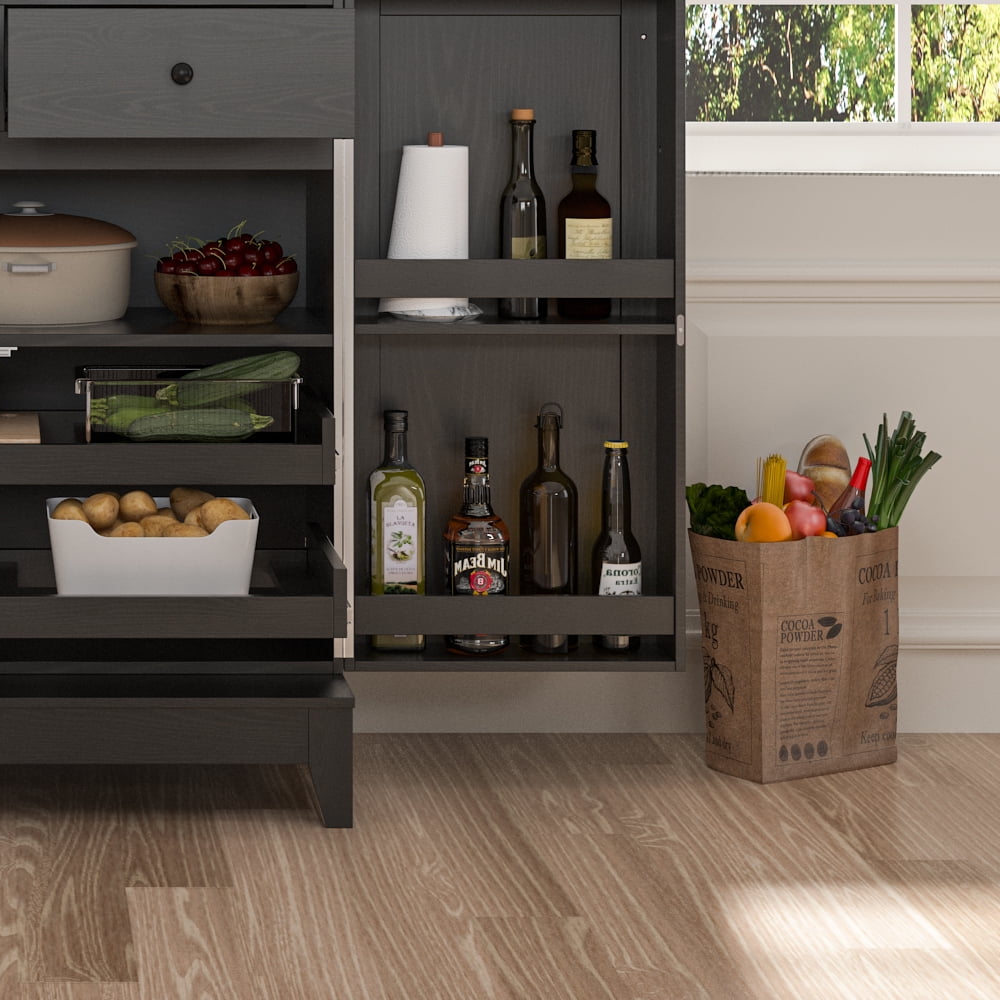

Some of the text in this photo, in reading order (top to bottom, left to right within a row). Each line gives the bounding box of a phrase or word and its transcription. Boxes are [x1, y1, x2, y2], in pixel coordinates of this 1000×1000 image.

[858, 562, 892, 585] COCOA
[780, 618, 815, 632] COCOA
[883, 608, 891, 636] 1
[780, 629, 824, 644] POWDER
